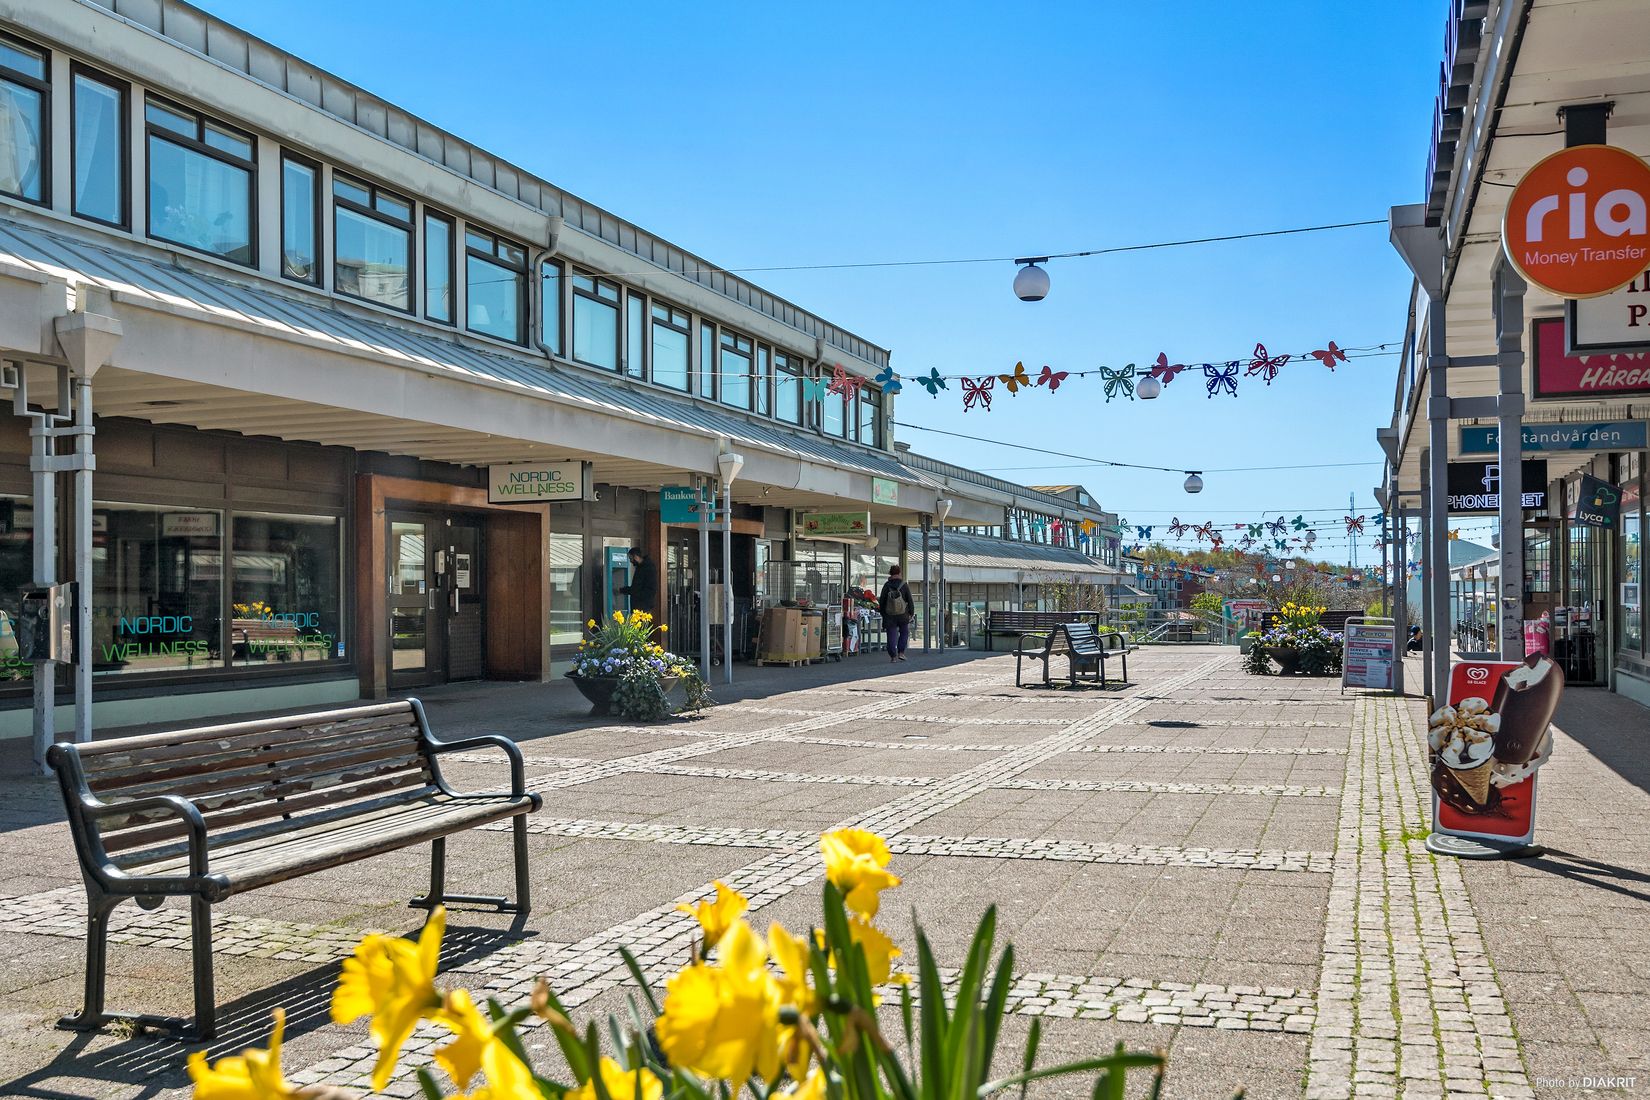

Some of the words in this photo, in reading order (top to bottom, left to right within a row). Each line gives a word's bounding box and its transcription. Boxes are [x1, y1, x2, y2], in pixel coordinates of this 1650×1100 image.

[1525, 167, 1647, 243] ria
[1525, 251, 1578, 266] Money
[1580, 245, 1647, 261] Transfer
[1486, 429, 1621, 445] Ftandvården
[509, 471, 562, 483] NORDIC
[498, 482, 575, 495] WELLNESS
[1579, 511, 1604, 522] Lyca
[120, 615, 193, 635] NORDIC
[261, 612, 320, 629] NORDIC
[102, 640, 209, 662] WELLNESS
[248, 634, 332, 654] WELLNESS
